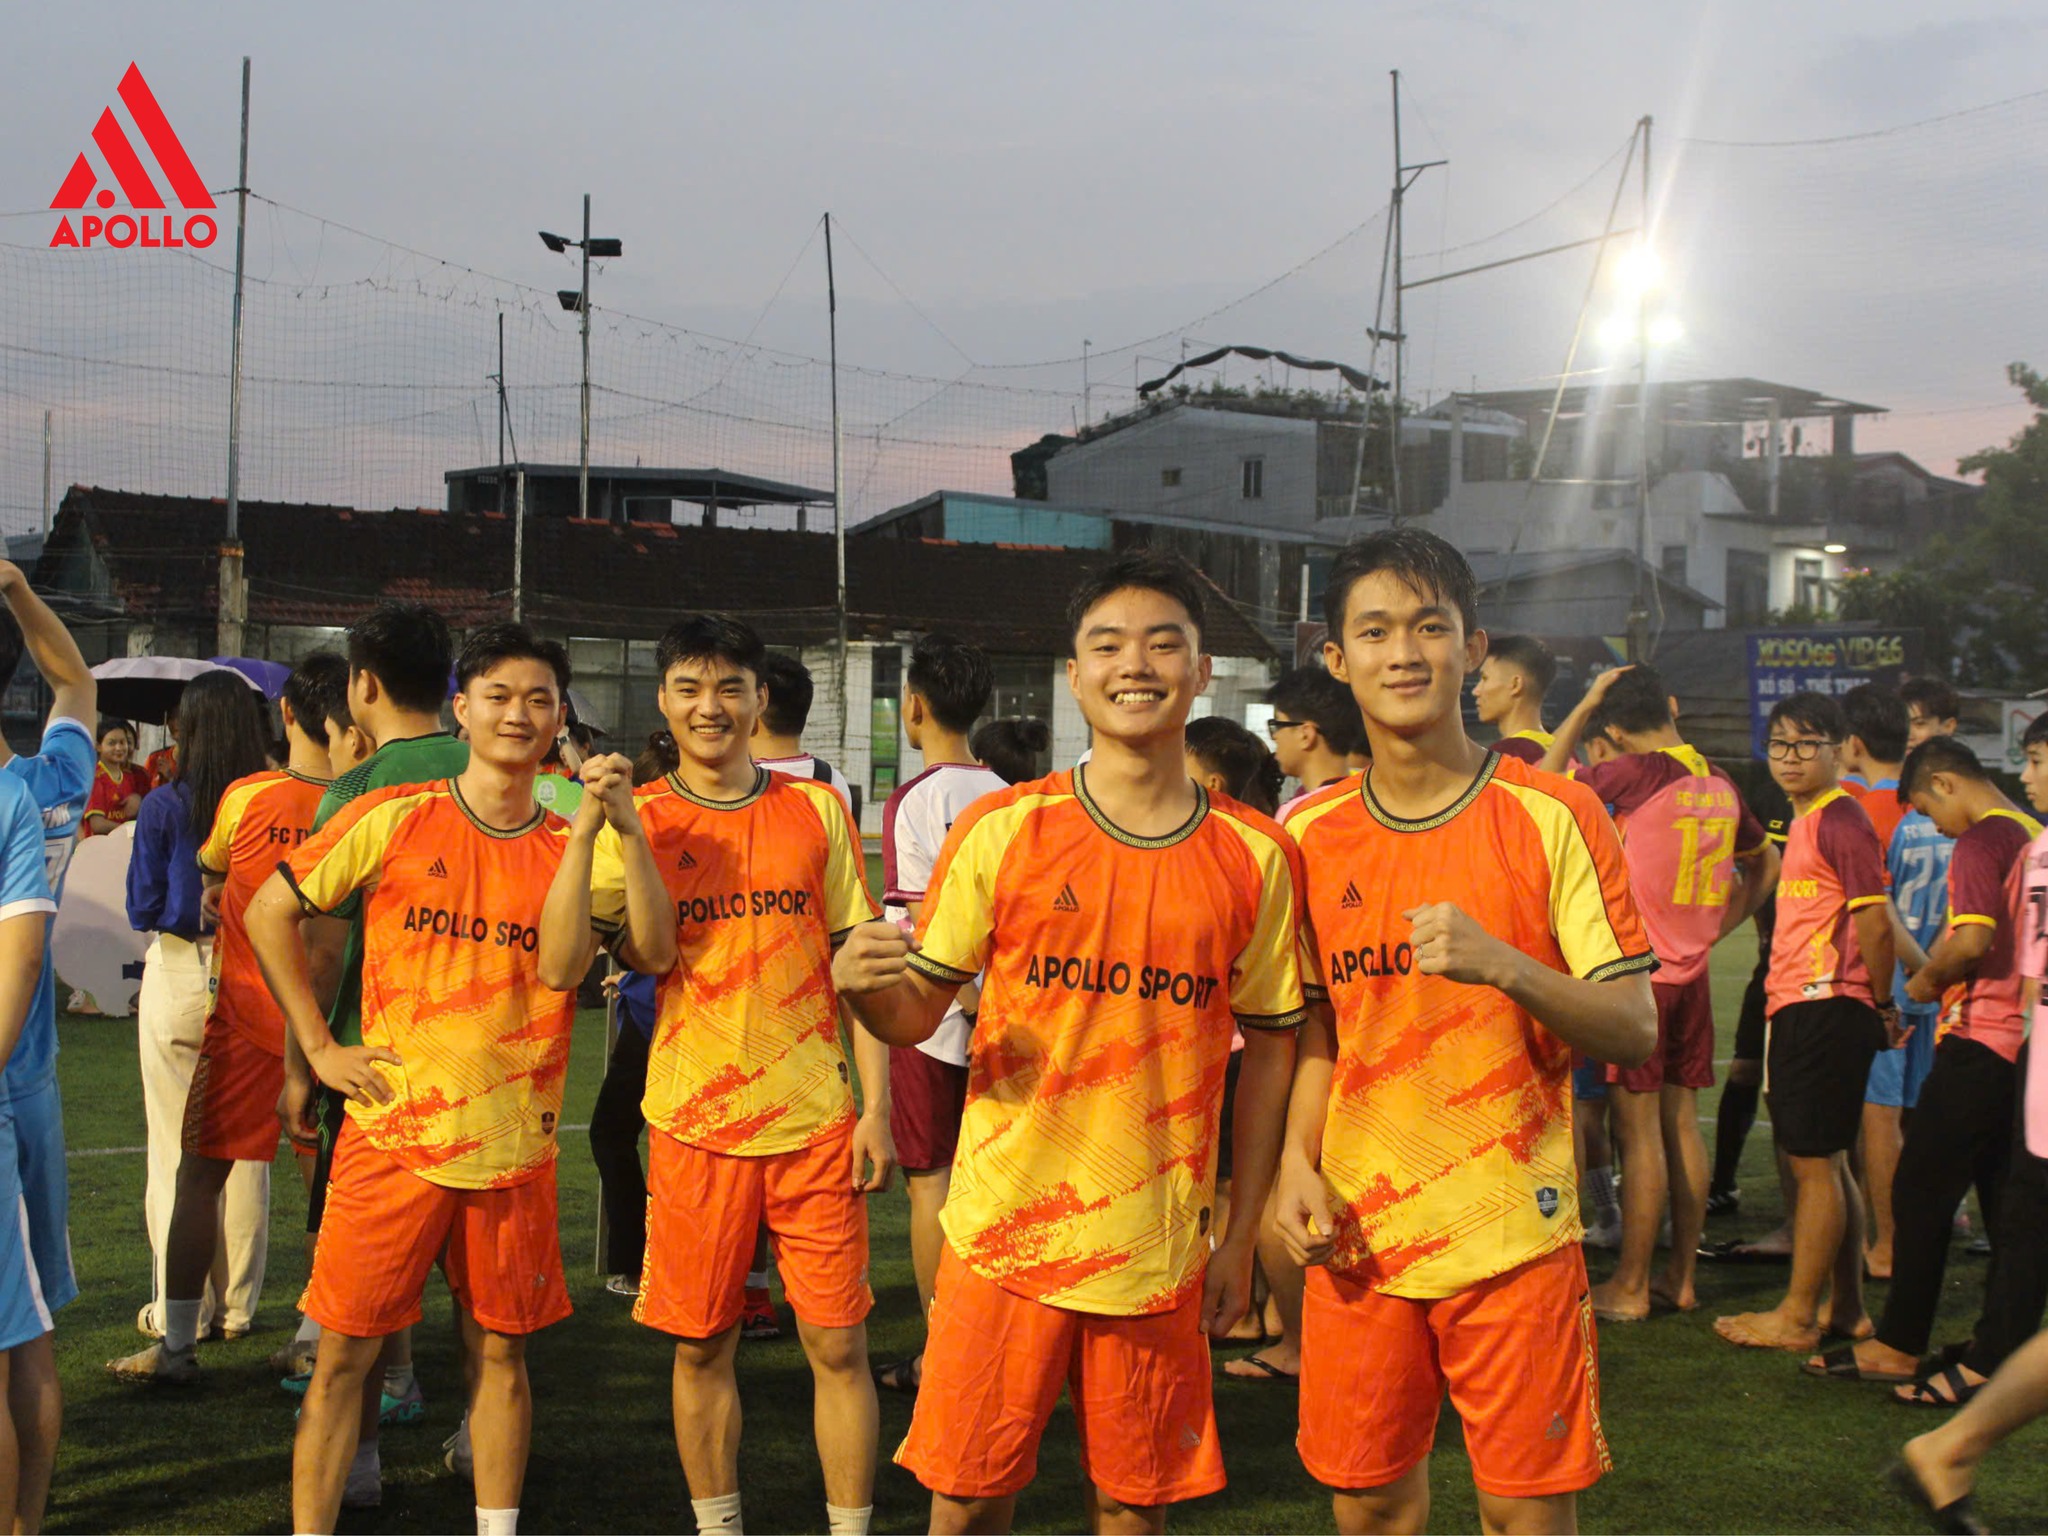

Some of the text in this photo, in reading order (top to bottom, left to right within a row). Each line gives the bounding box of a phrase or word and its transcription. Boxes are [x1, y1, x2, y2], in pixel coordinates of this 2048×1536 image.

[269, 827, 290, 844] FC
[1670, 816, 1738, 906] 12
[403, 906, 538, 952] APOLLO SPO
[677, 892, 746, 926] POLLO
[1024, 954, 1219, 1009] APOLLO SPORT
[1331, 941, 1412, 986] APOLLO
